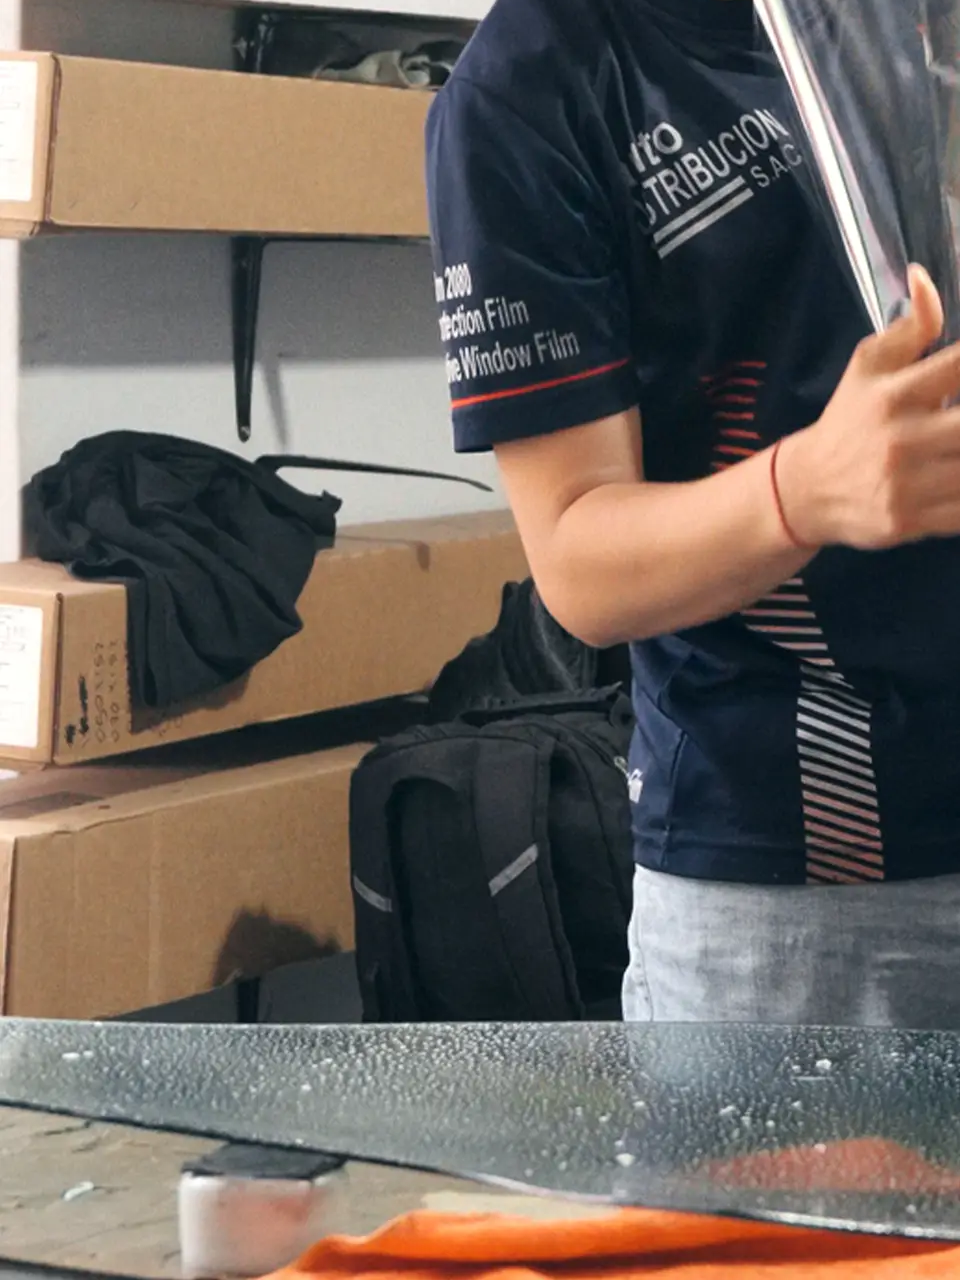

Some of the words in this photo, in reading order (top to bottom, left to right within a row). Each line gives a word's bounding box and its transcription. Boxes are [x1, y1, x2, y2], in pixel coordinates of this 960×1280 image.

[484, 296, 530, 330] Film
[459, 340, 531, 380] Window
[533, 328, 580, 365] Film
